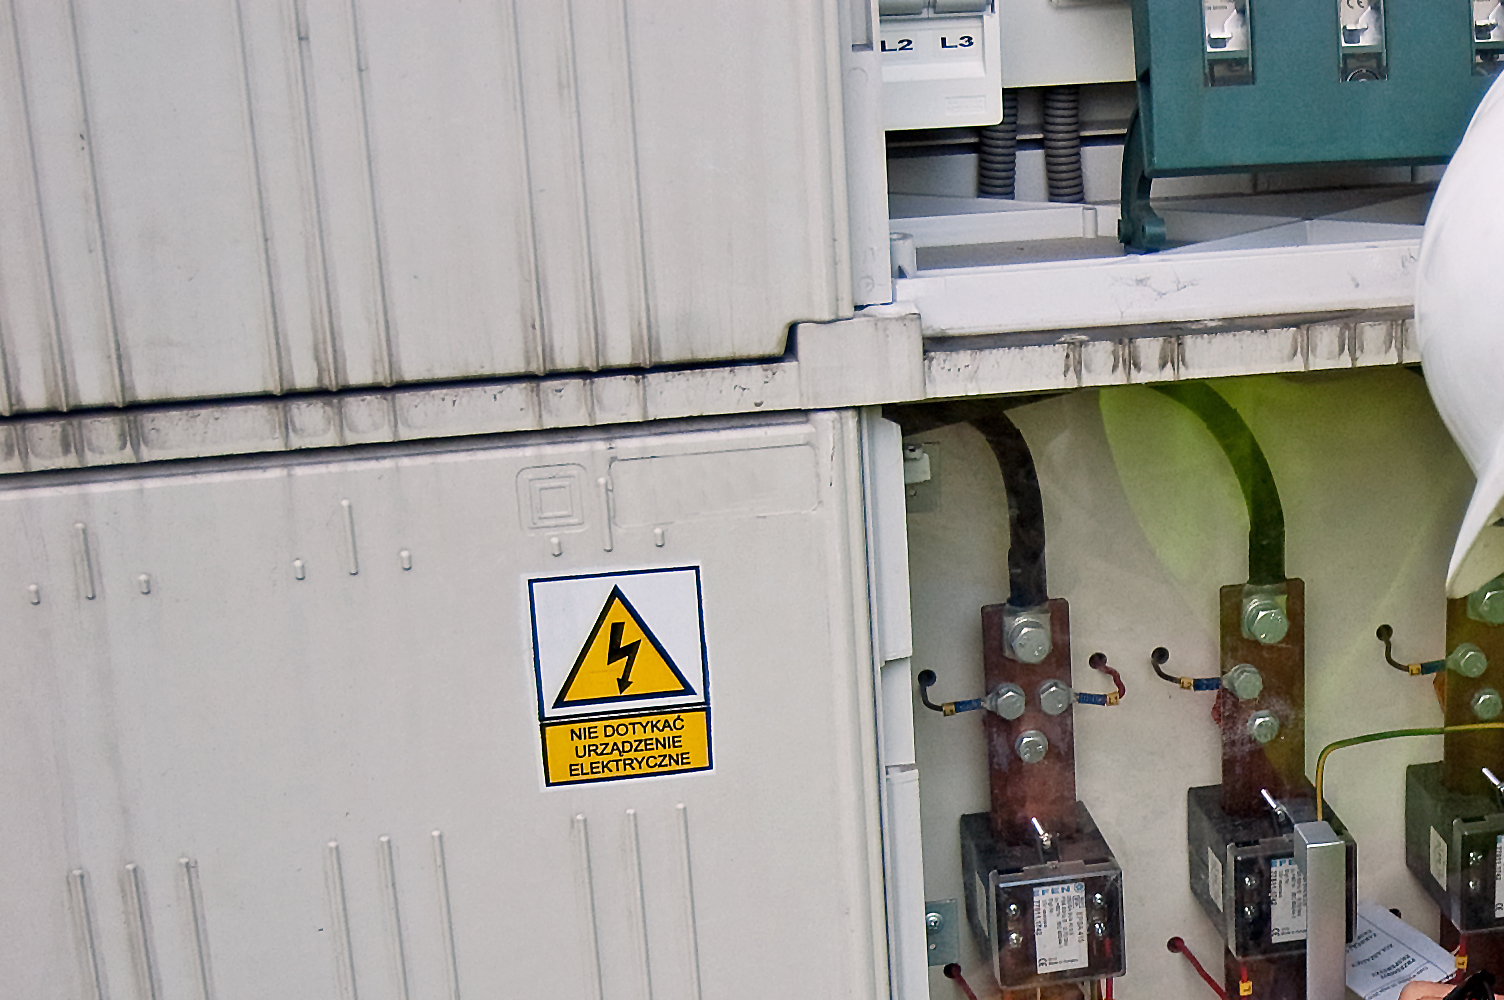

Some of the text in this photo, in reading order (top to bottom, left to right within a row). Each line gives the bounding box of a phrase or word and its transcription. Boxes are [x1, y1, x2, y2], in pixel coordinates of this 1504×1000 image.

[880, 35, 974, 52] L2 L3
[570, 715, 685, 742] NIE DOTYKAĆ
[575, 735, 683, 759] URZĄDZENIE
[569, 752, 691, 777] ELEKTRYCZNE
